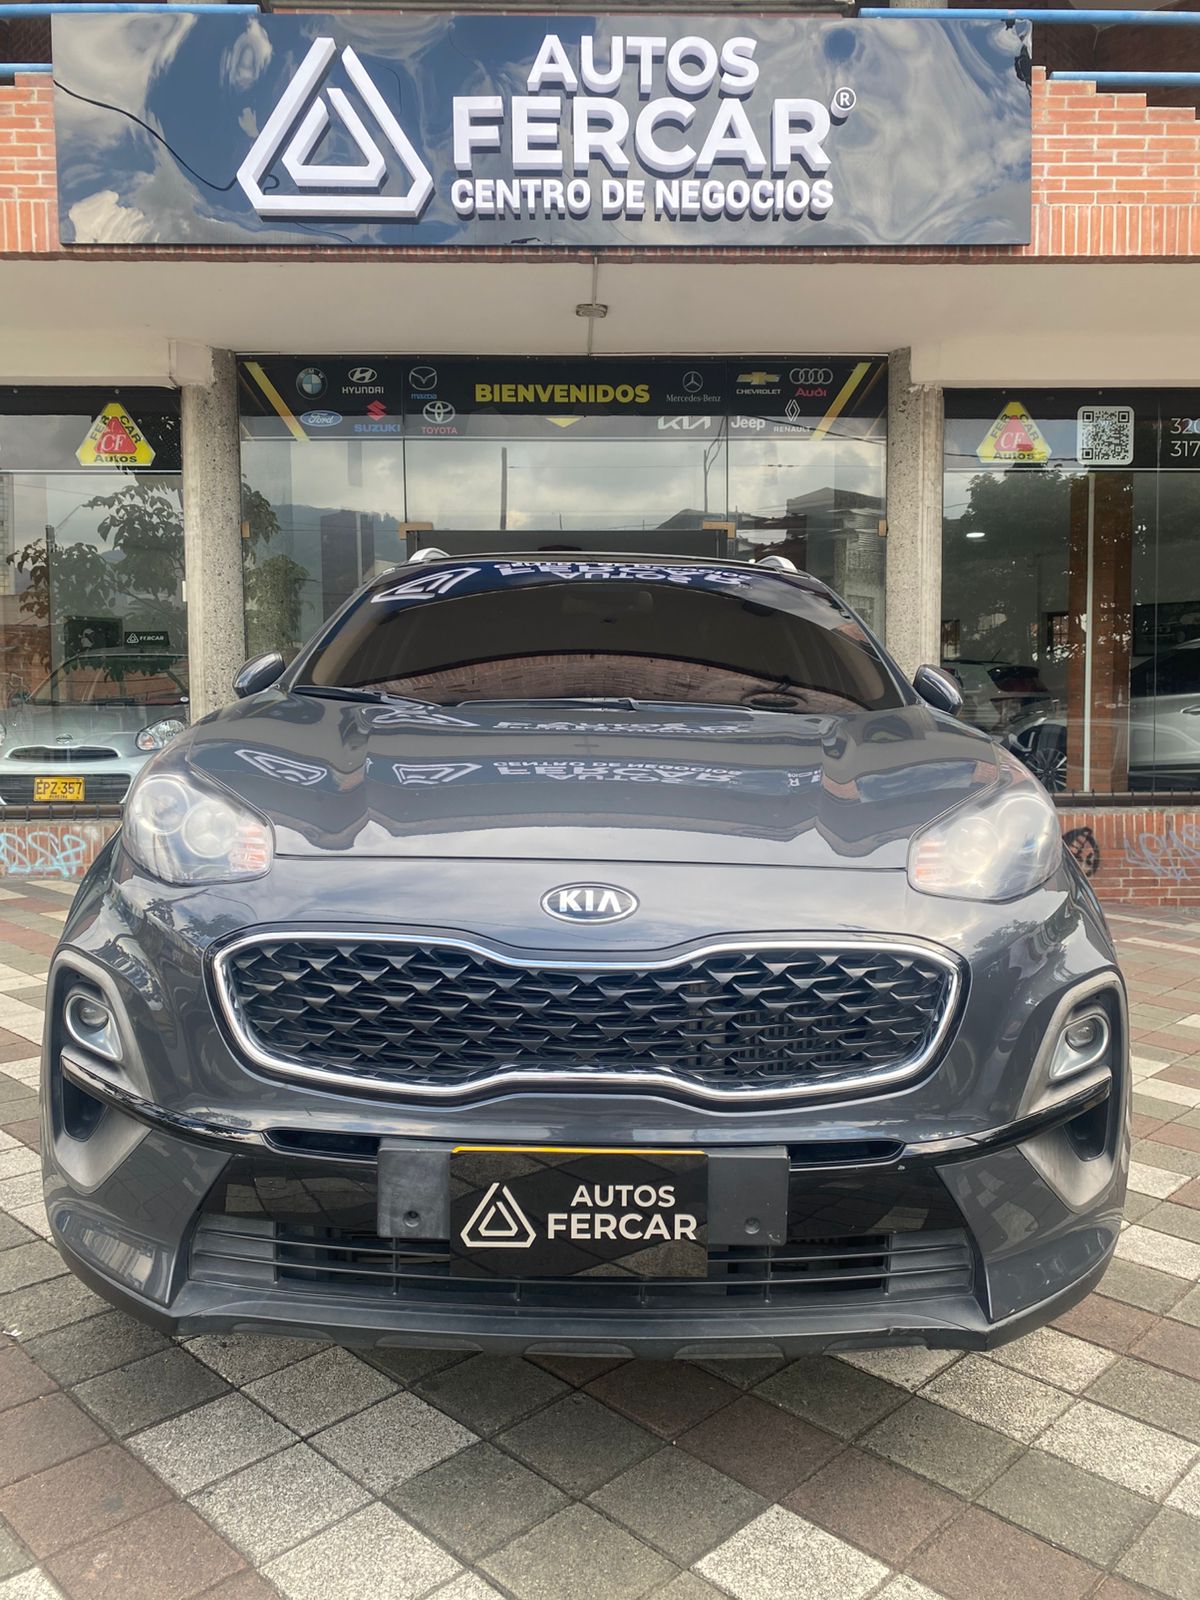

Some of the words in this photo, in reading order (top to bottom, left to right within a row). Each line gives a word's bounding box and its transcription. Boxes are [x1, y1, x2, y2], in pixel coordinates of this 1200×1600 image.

[527, 34, 760, 94] AUTOS
[452, 95, 832, 172] FERCAR
[451, 178, 591, 216] CENTRO
[602, 178, 646, 213] DE
[655, 178, 834, 217] NEGOCIOS
[342, 386, 384, 395] HYUNDAI
[475, 383, 650, 403] BIENVENIDOS
[666, 393, 722, 402] Mercedes-Benz
[796, 387, 827, 397] Audi
[308, 412, 335, 424] Ford
[731, 415, 766, 430] Jeep
[354, 424, 400, 433] SUZUKI
[421, 426, 458, 435] TOYOTA
[1170, 440, 1200, 457] 317
[559, 889, 622, 913] KIA
[570, 1184, 677, 1208] AUTOS
[546, 1213, 698, 1241] FERCAR
